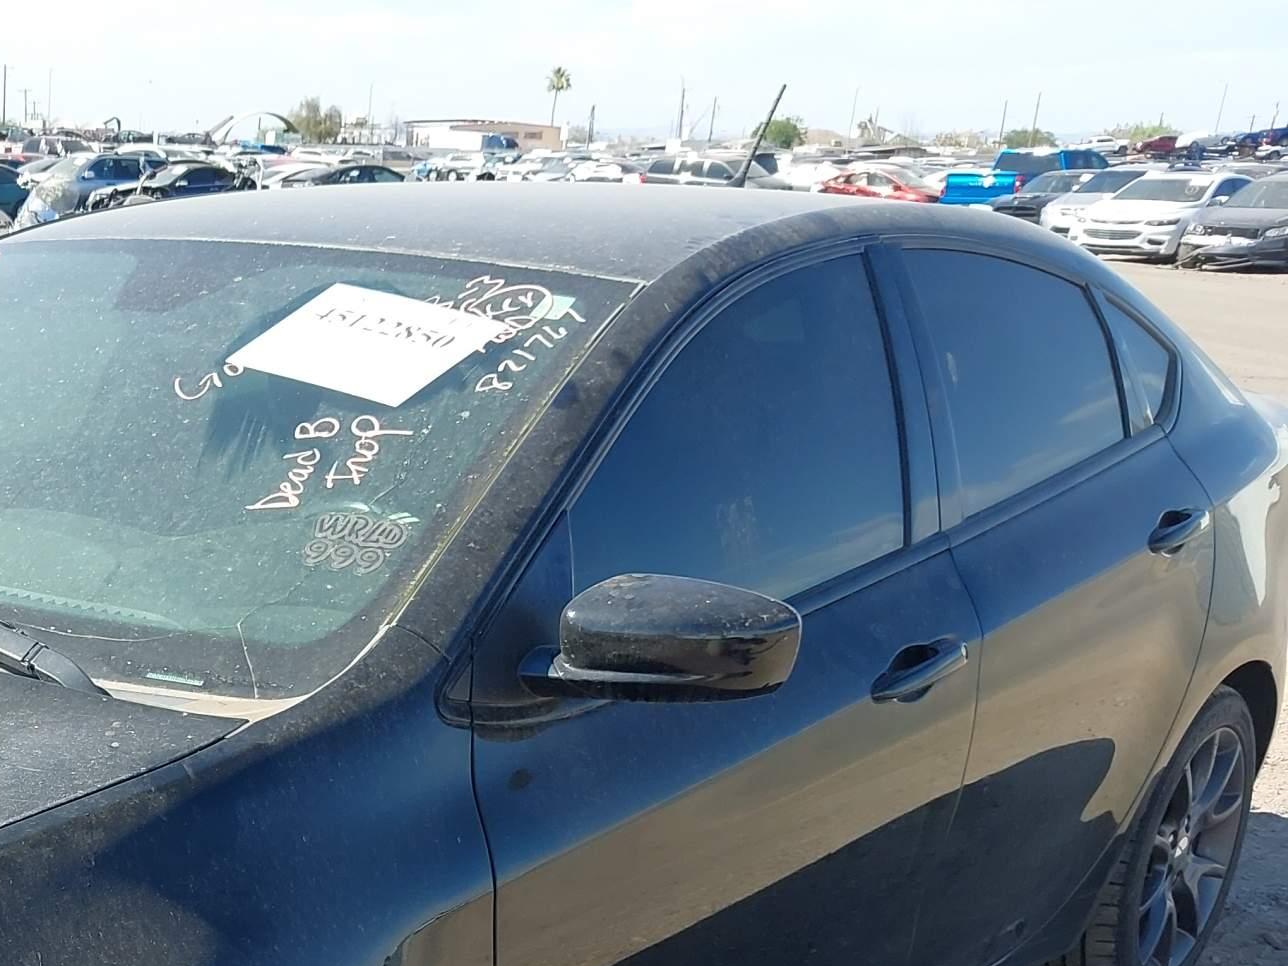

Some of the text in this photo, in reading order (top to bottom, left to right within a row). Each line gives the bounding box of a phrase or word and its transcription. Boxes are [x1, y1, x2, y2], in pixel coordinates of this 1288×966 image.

[246, 416, 341, 511] Dead B
[303, 537, 386, 576] 999
